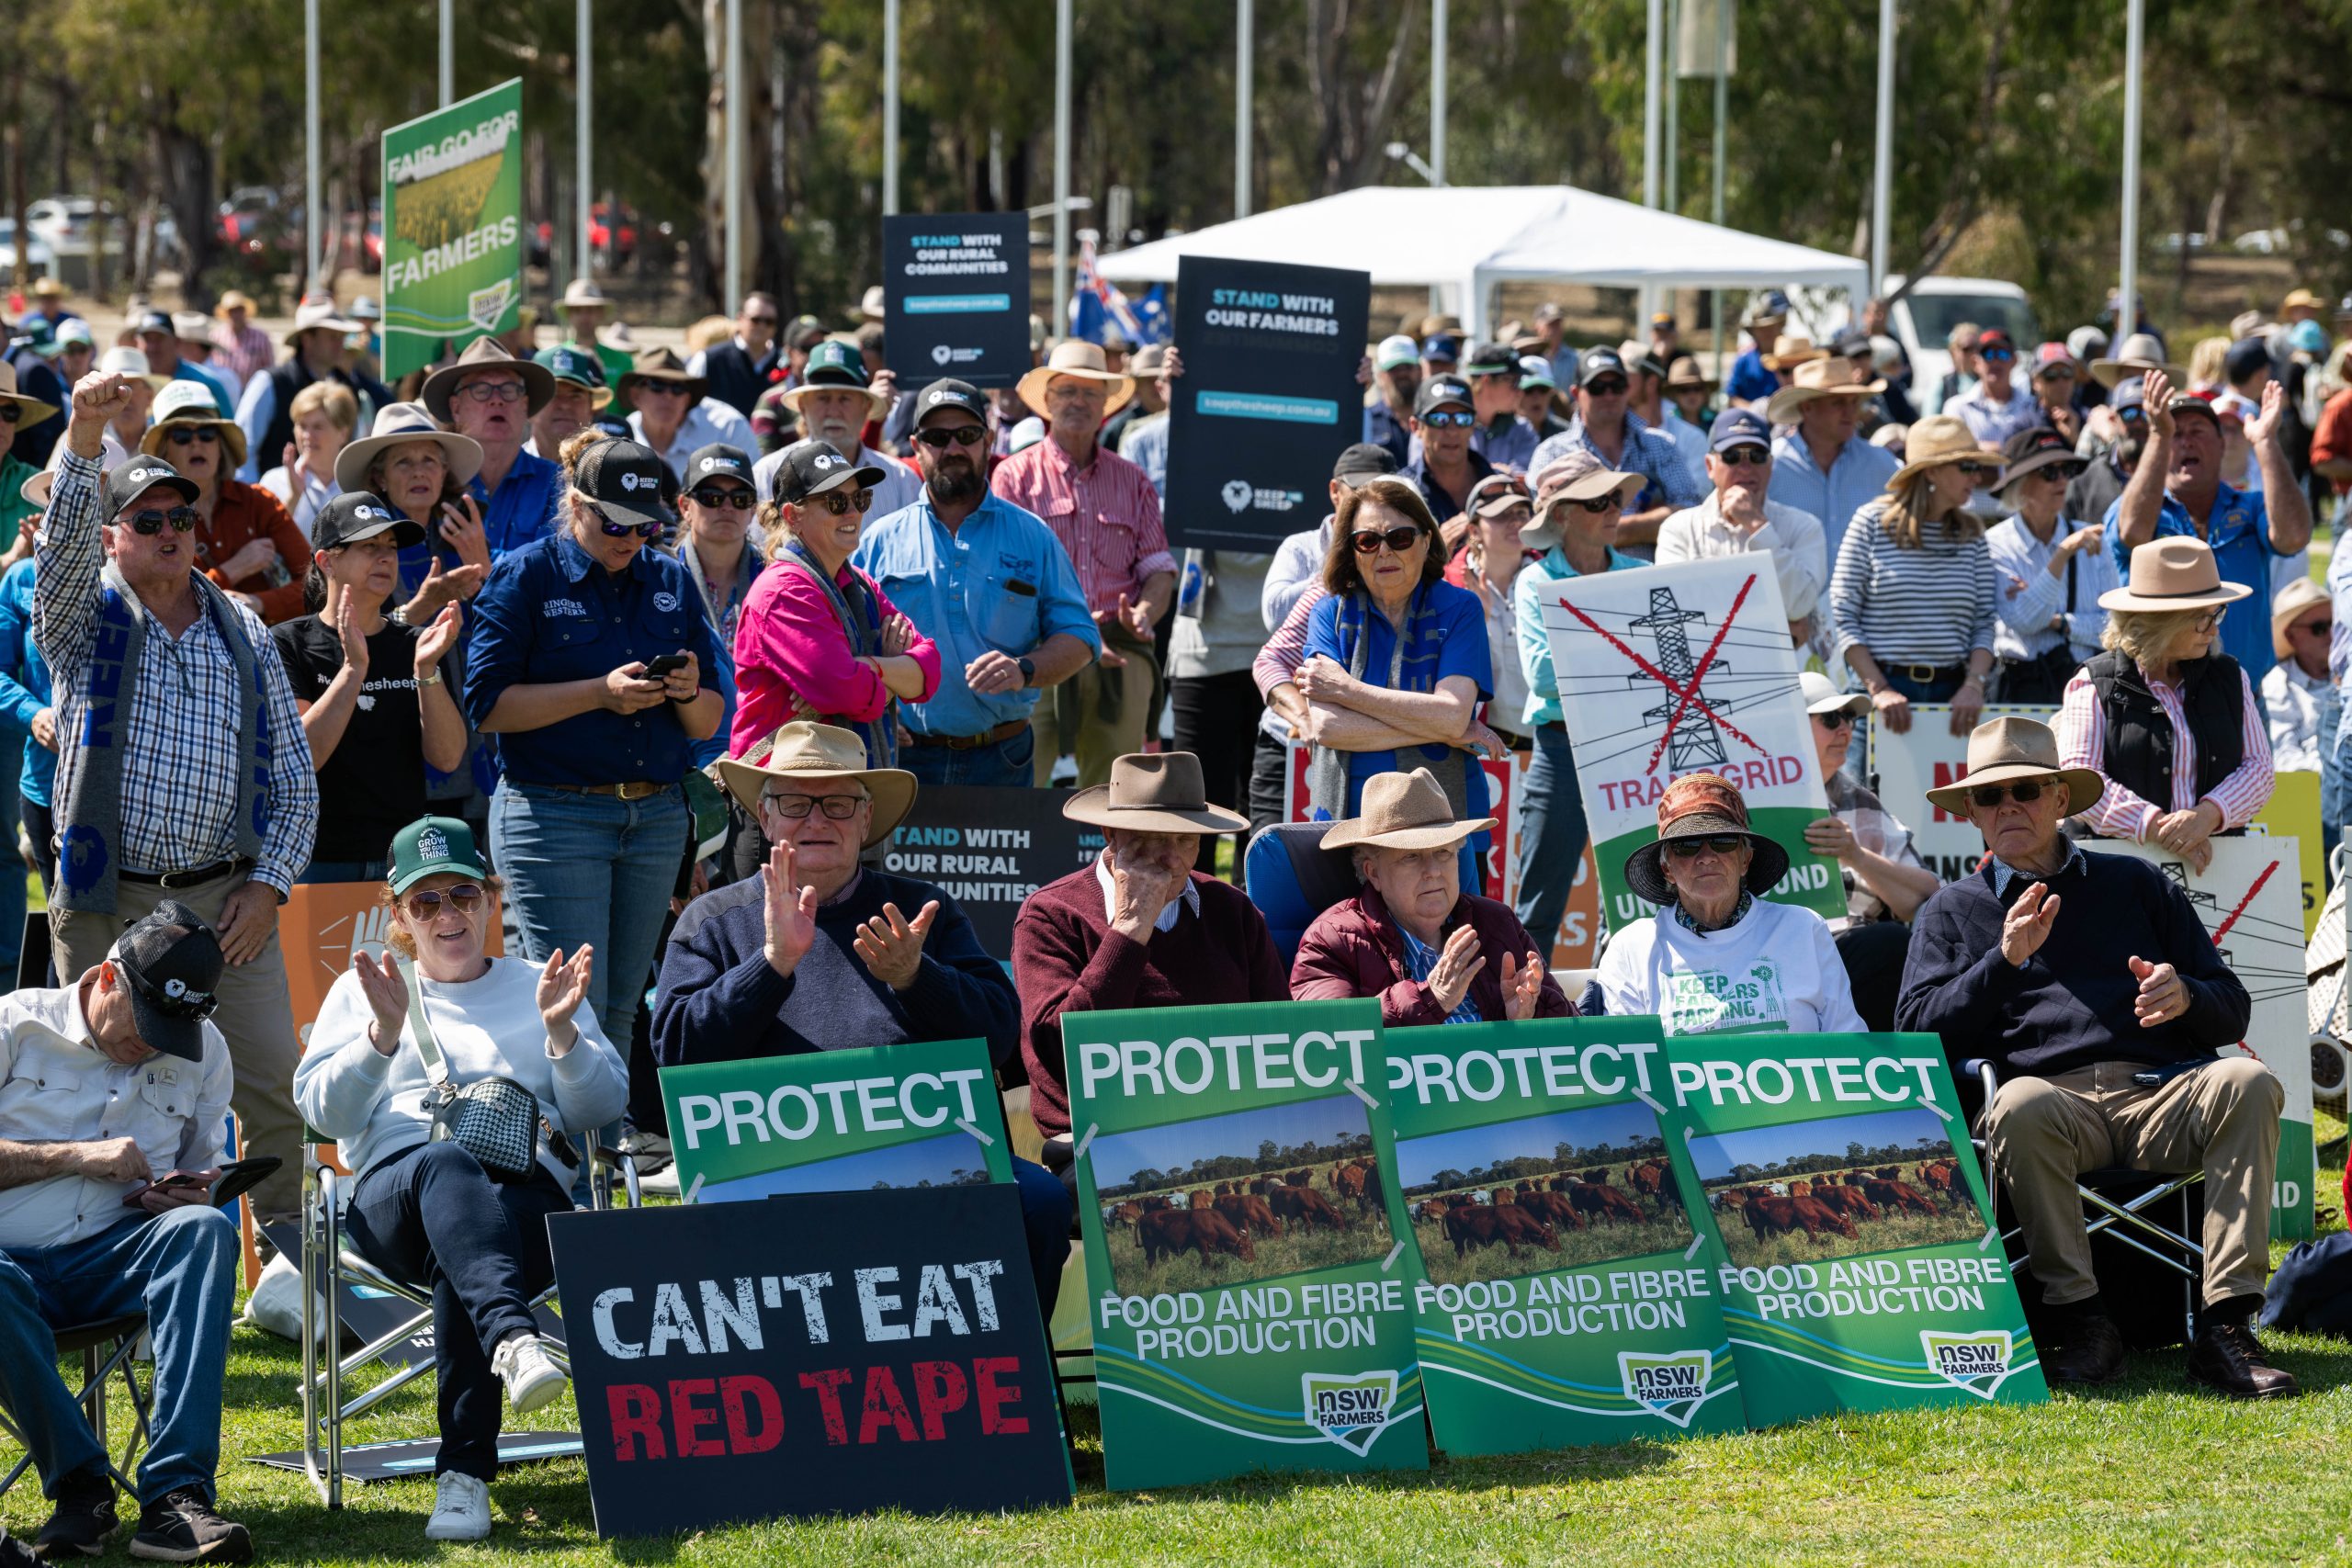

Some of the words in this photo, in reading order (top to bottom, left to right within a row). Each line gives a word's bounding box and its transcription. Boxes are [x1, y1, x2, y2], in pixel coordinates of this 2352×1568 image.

[387, 143, 437, 184] FAIR
[439, 129, 471, 155] GO
[476, 109, 519, 141] FOR
[910, 236, 960, 247] STAND
[962, 234, 1001, 246] WITH
[387, 215, 518, 294] FARMERS
[916, 249, 948, 261] OUR
[949, 248, 997, 260] RURAL
[904, 261, 1009, 276] COMMUNITIES
[1213, 288, 1279, 309] STAND
[1282, 295, 1334, 314] WITH
[1204, 310, 1247, 328] OUR
[1248, 312, 1339, 336] FARMERS
[543, 605, 587, 618] WESTERN
[544, 598, 583, 609] RINGERS
[418, 836, 446, 848] GROW
[432, 844, 447, 852] GOOD
[894, 827, 960, 847] TAND
[965, 829, 1030, 849] WITH
[420, 850, 448, 861] THING
[885, 852, 937, 873] OUR
[941, 854, 1020, 875] RURAL
[1679, 976, 1729, 994] KEEP
[1079, 1029, 1375, 1100] PROTECT
[1385, 1043, 1658, 1104] PROTECT
[1669, 1056, 1939, 1107] PROTECT
[678, 1068, 985, 1150] PROTECT
[1718, 1263, 1818, 1294] FOOD
[1829, 1259, 1901, 1288] AND
[1906, 1258, 2007, 1285] FIBRE
[1414, 1280, 1517, 1314] FOOD
[1527, 1274, 1602, 1306] AND
[1609, 1269, 1711, 1302] FIBRE
[1756, 1285, 1985, 1321] PRODUCTION
[592, 1271, 832, 1359] CAN'T
[854, 1259, 1003, 1342] EAT
[1101, 1292, 1204, 1329] FOOD
[1215, 1286, 1294, 1322] AND
[1301, 1280, 1405, 1316] FIBRE
[1452, 1300, 1687, 1342] PRODUCTION
[1136, 1315, 1376, 1360] PRODUCTION
[1938, 1345, 1996, 1364] nsw
[1635, 1366, 1696, 1388] nsw
[1943, 1361, 2005, 1375] FARMERS
[1318, 1388, 1381, 1413] nsw
[1639, 1385, 1702, 1401] FARMERS
[605, 1375, 785, 1461] RED
[798, 1357, 1030, 1446] TAPE
[1320, 1411, 1385, 1427] FARMERS
